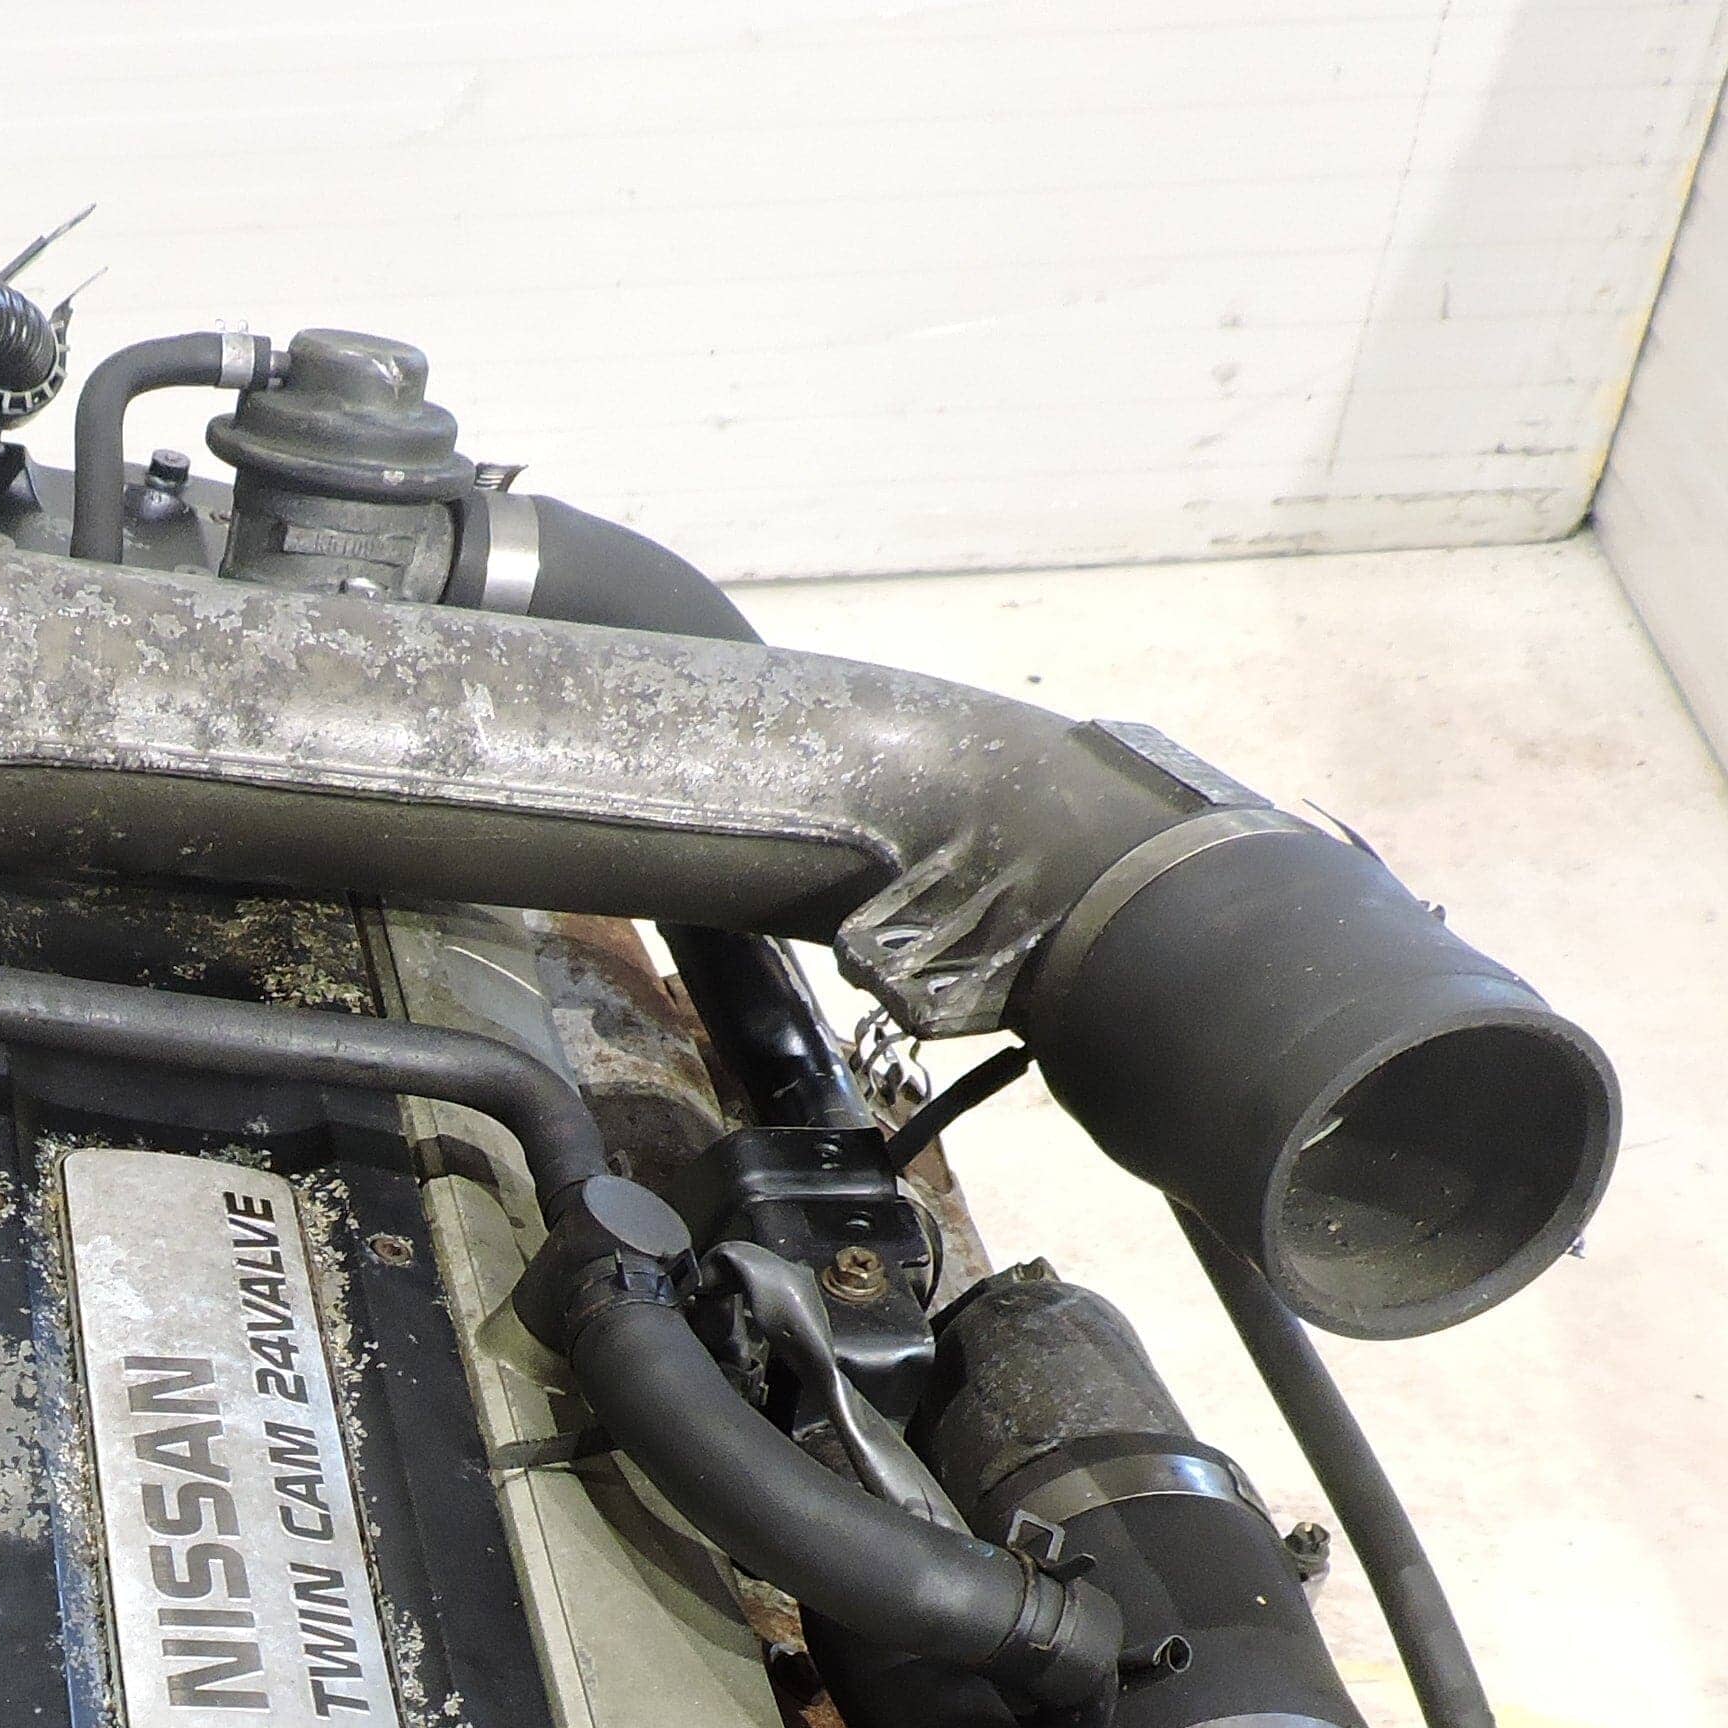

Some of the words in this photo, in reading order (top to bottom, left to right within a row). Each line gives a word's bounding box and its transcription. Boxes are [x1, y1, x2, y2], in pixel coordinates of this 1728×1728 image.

[224, 1190, 310, 1405] 24VALVE
[122, 1355, 271, 1712] NISSAN
[266, 1420, 334, 1542] CAM
[289, 1563, 370, 1720] TWIN
